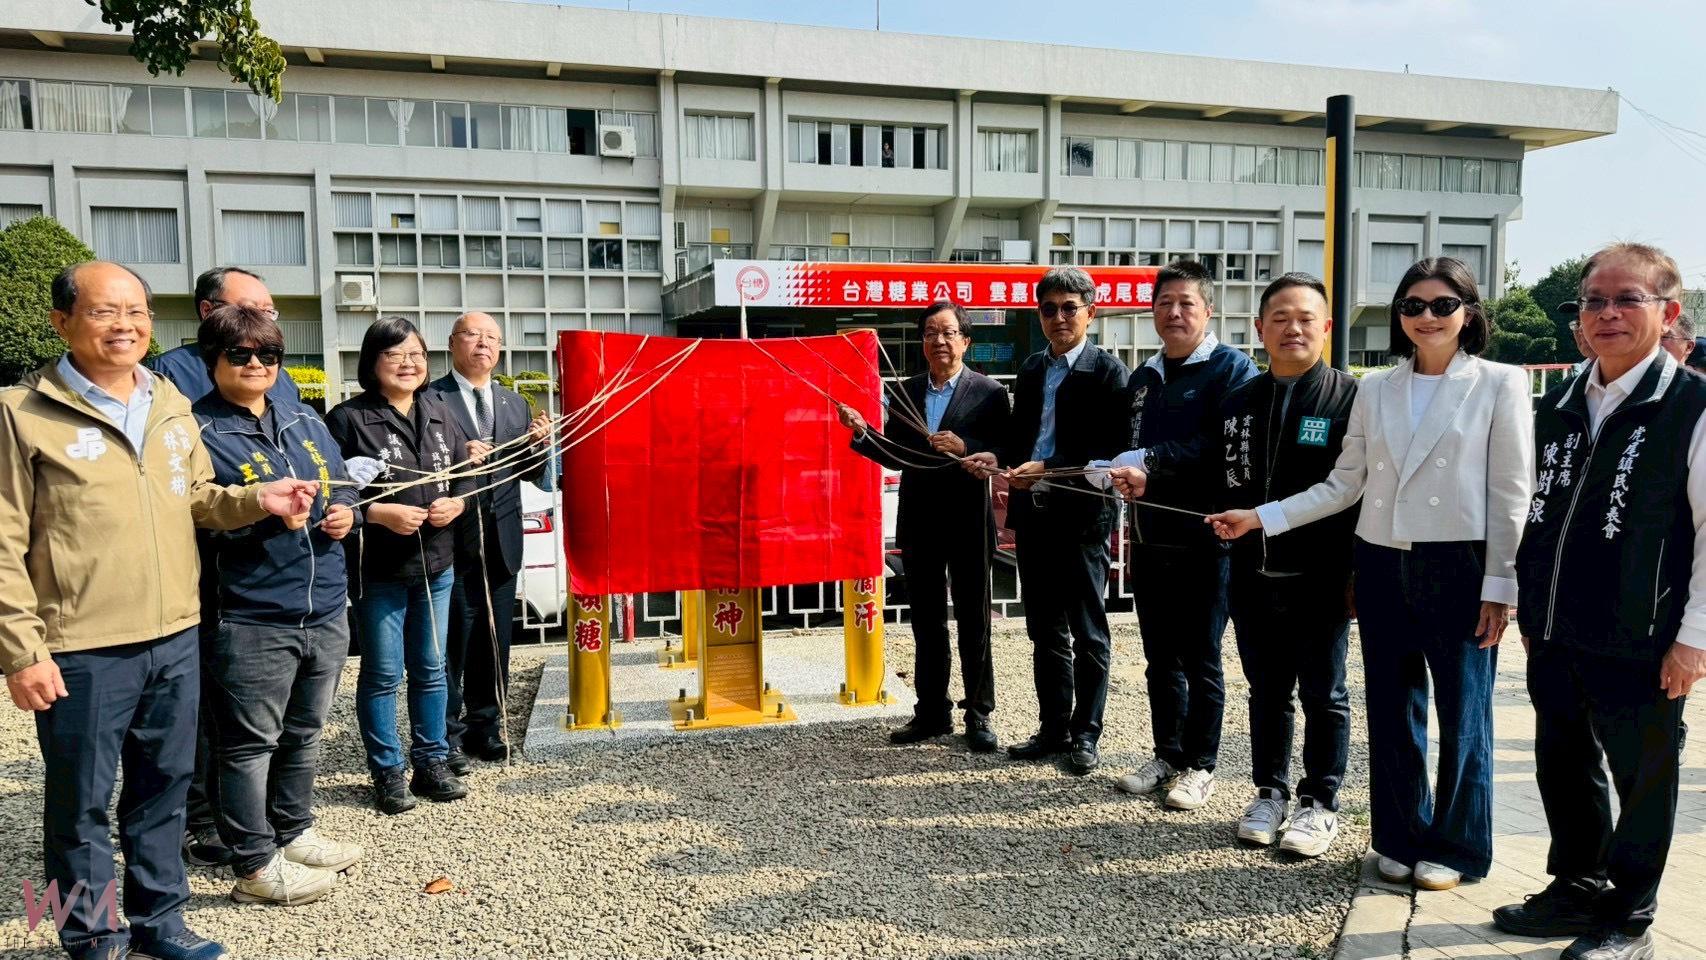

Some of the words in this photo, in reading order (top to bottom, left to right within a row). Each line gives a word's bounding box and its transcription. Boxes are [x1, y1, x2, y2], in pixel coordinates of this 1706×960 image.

[841, 279, 973, 303] 台灣糖業公司
[989, 281, 1038, 303] 雲嘉
[1096, 282, 1153, 304] 虎尾糖
[164, 430, 187, 497] 林文彬
[1223, 416, 1242, 488] 陳乙辰
[1240, 414, 1254, 481] 雲林縣議員
[1554, 432, 1582, 488] 副主席
[1601, 425, 1646, 540] 虎尾鎮民代表會
